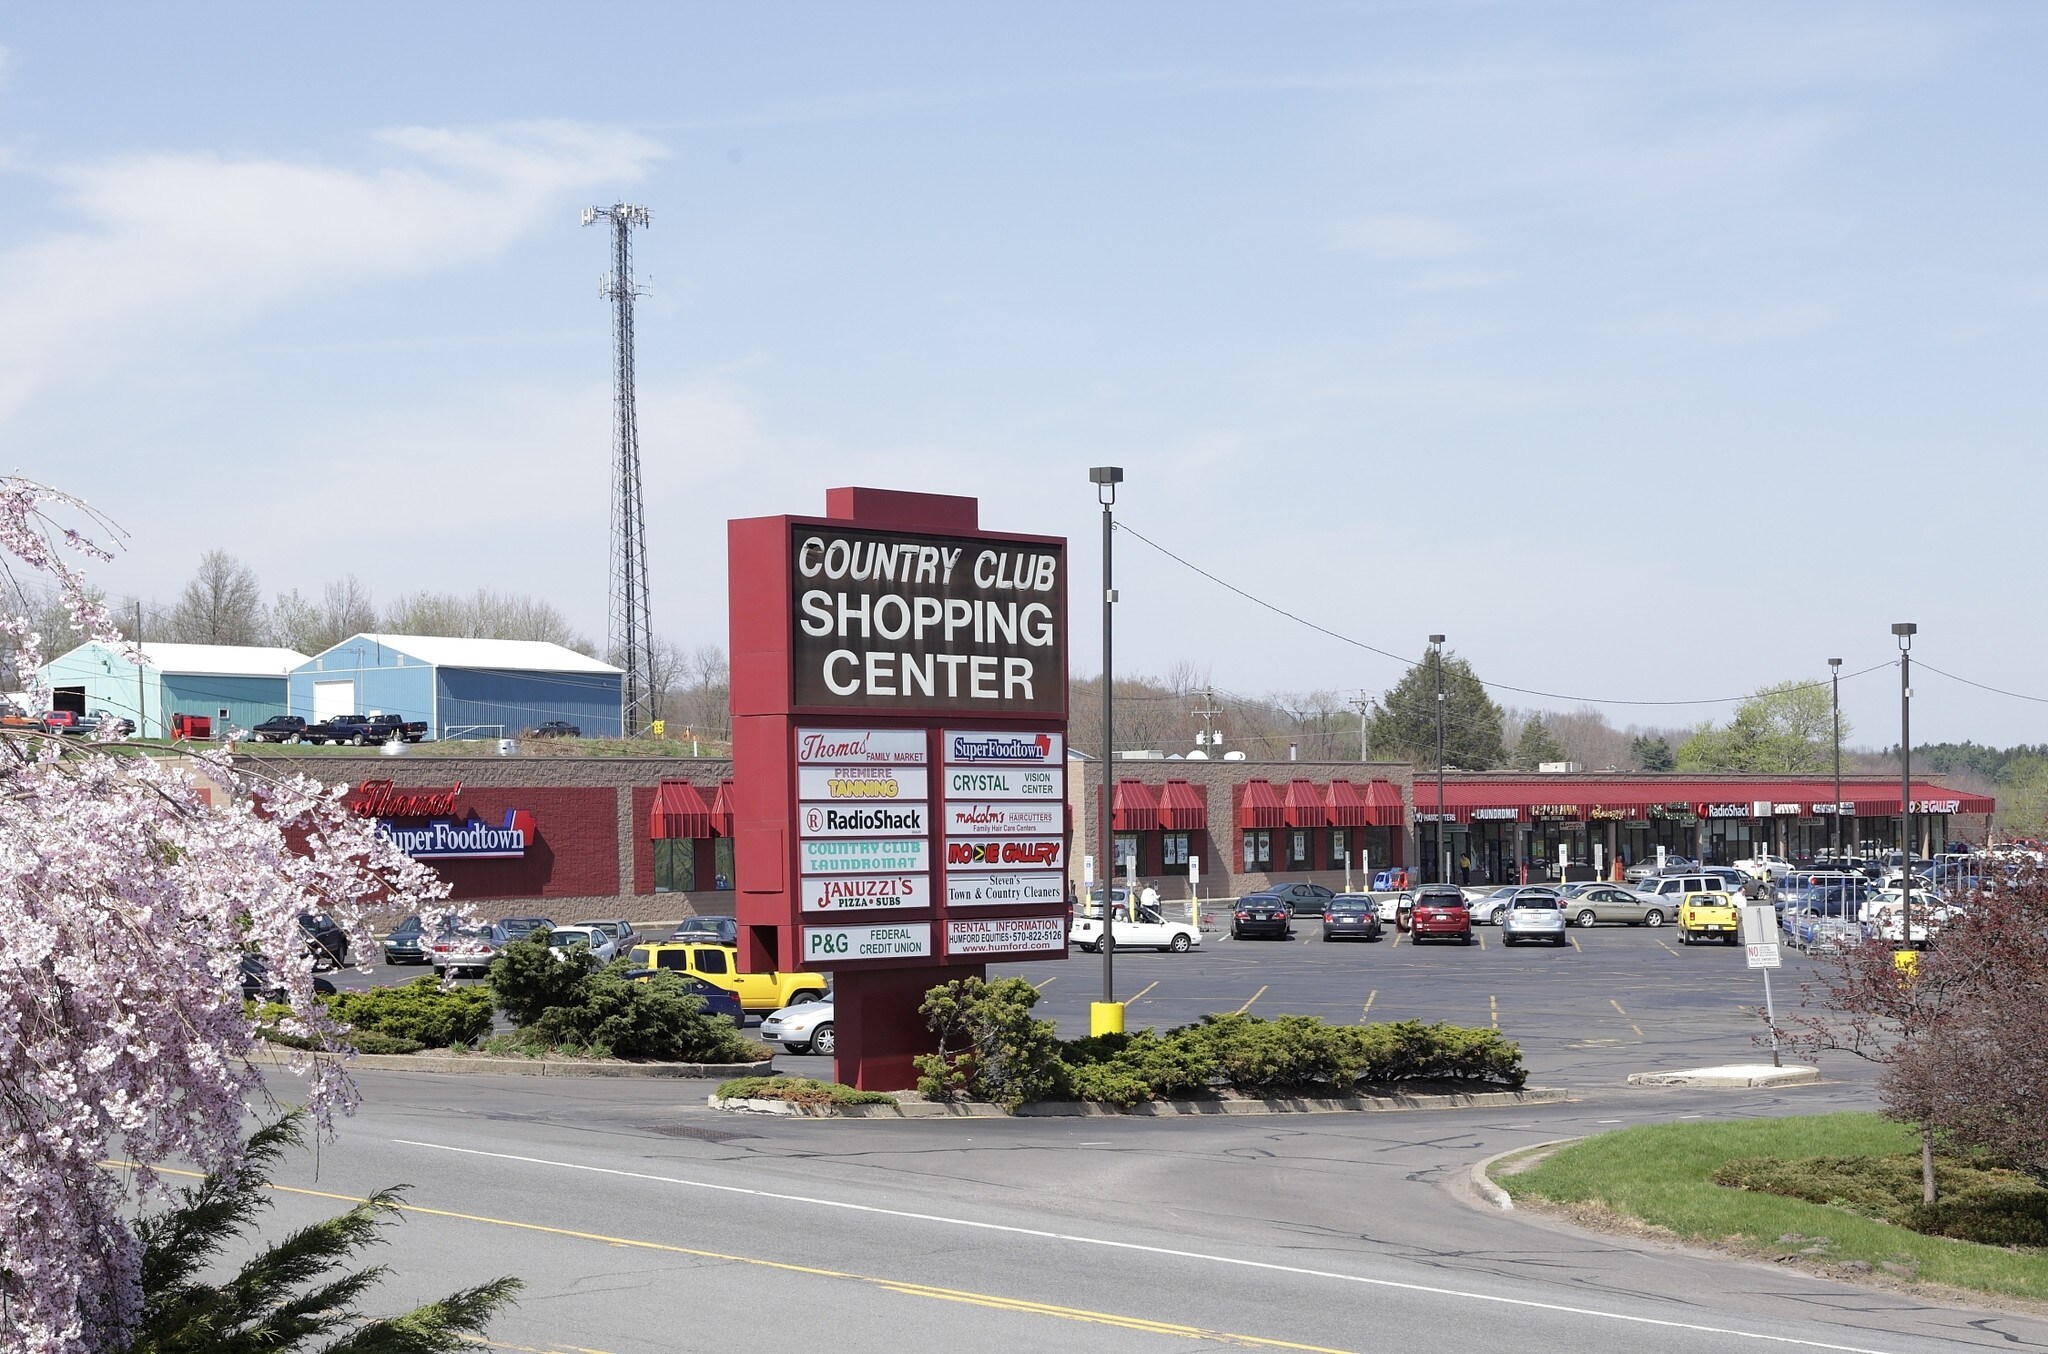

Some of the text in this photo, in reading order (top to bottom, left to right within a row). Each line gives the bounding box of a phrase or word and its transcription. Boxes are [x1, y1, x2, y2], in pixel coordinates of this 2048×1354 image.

[799, 536, 1056, 592] COUNTRY CLUB
[800, 589, 1054, 647] SHOPPING
[823, 649, 1034, 700] CENTER
[800, 732, 871, 761] Thomas'
[866, 752, 924, 762] FAMILY MARKET
[834, 768, 892, 779] PREMIERE
[1024, 773, 1051, 783] VISION
[827, 779, 899, 798] TANNING
[953, 775, 1010, 791] CRYSTAL
[1022, 784, 1054, 794] CENTER
[956, 804, 1053, 824] malcolm's HAIRCUTTERS
[1475, 808, 1519, 820] LAUNDROMAT
[1708, 804, 1750, 817] RadioShack
[1929, 801, 1960, 815] GALLERY
[827, 809, 920, 830] RadioShack
[973, 825, 990, 833] Family
[1016, 824, 1037, 832] Centers
[807, 842, 921, 855] COUNTRY CLUB
[1002, 843, 1060, 866] GALLERY
[810, 858, 917, 871] LAUNDROMAT
[989, 875, 1021, 885] Steven's
[817, 877, 913, 908] JANUZZI'S
[948, 886, 1061, 900] Town & Country Cleaners
[838, 897, 901, 907] PIZZA SUBS
[953, 920, 1058, 933] RENTAL INFORMATION
[870, 929, 911, 940] FEDERAL
[949, 930, 1062, 943] HUMFORD EQUITIES 570-822-5126
[811, 933, 849, 954] P&G
[859, 942, 922, 955] CREDIT UNION
[962, 942, 1050, 953] www.humford.com
[1748, 946, 1758, 957] NO
